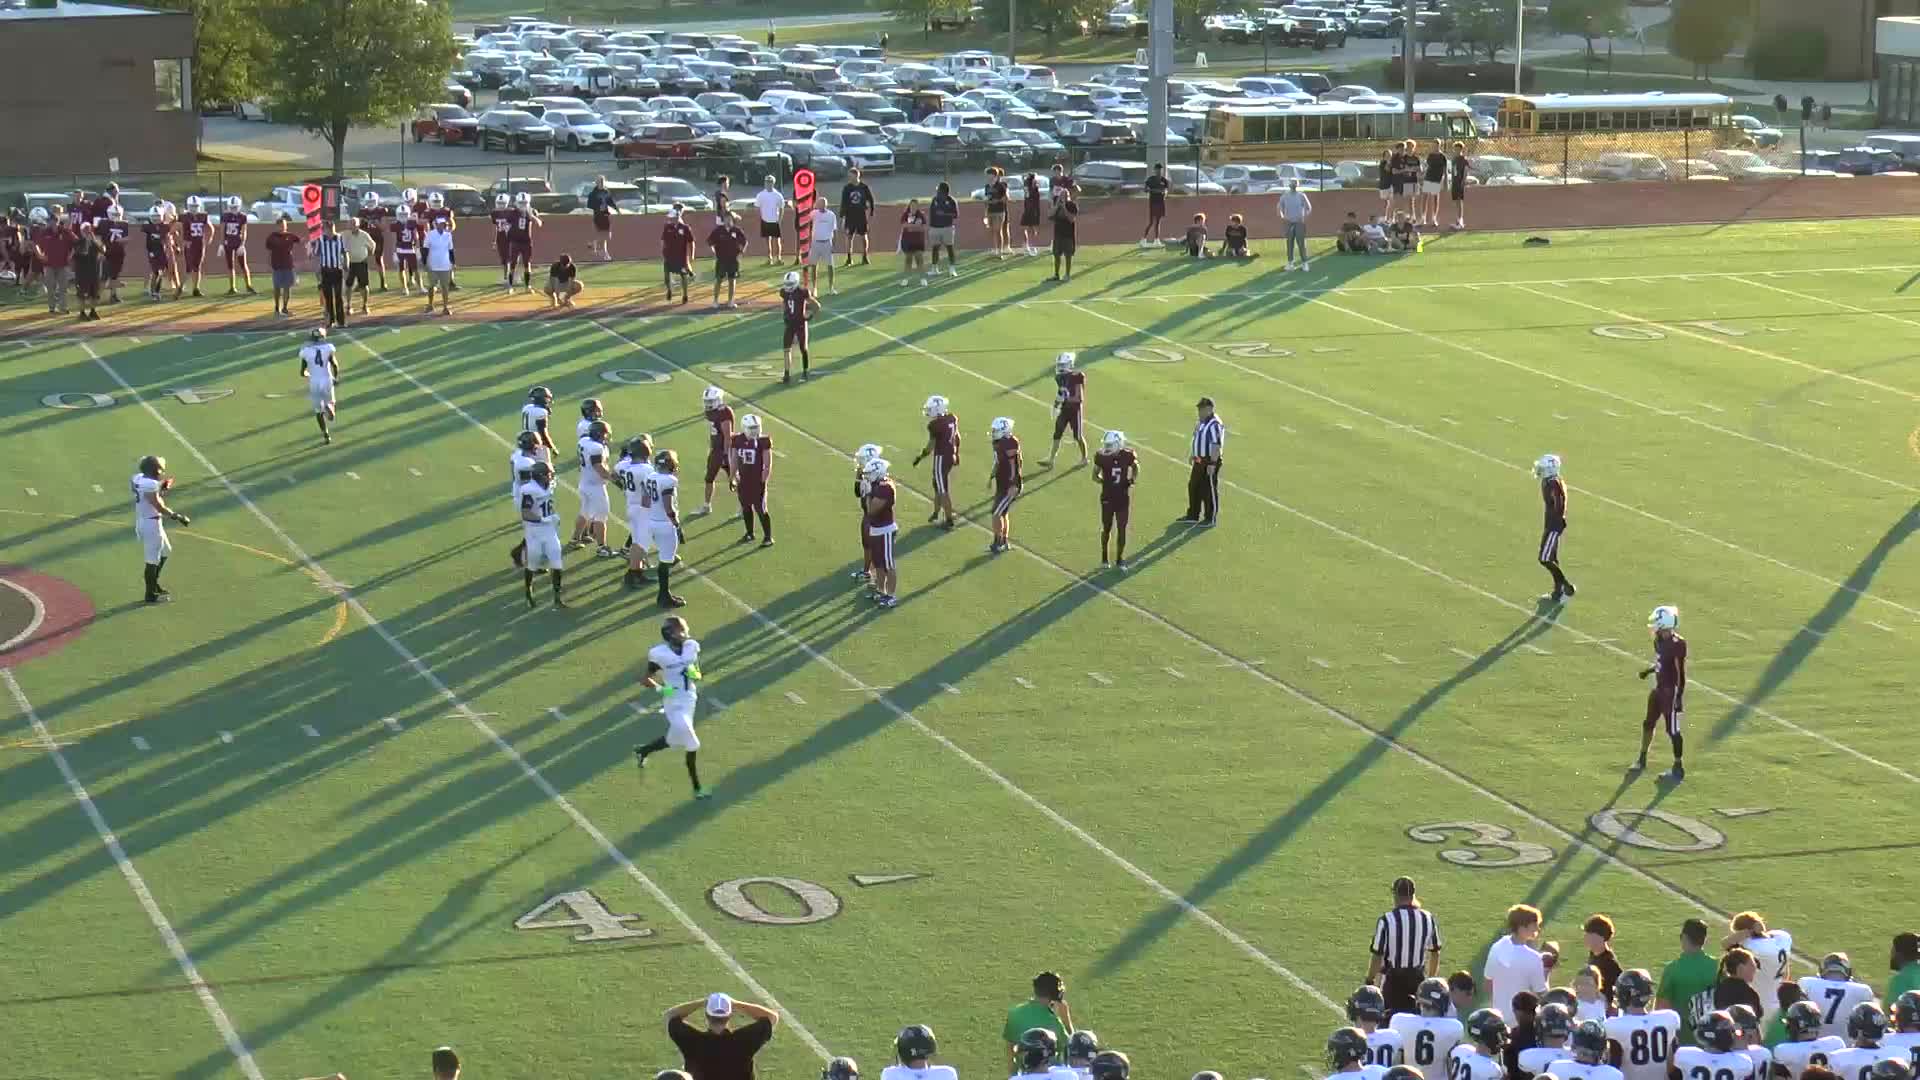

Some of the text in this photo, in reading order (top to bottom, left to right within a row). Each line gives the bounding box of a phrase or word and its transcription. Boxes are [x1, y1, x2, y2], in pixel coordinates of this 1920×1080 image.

[314, 349, 324, 367] 4
[1111, 467, 1122, 484] 5
[512, 875, 846, 944] 40
[1775, 948, 1787, 979] 2
[1823, 987, 1846, 1025] 7
[1415, 1029, 1435, 1065] 6
[1630, 1025, 1668, 1066] 80
